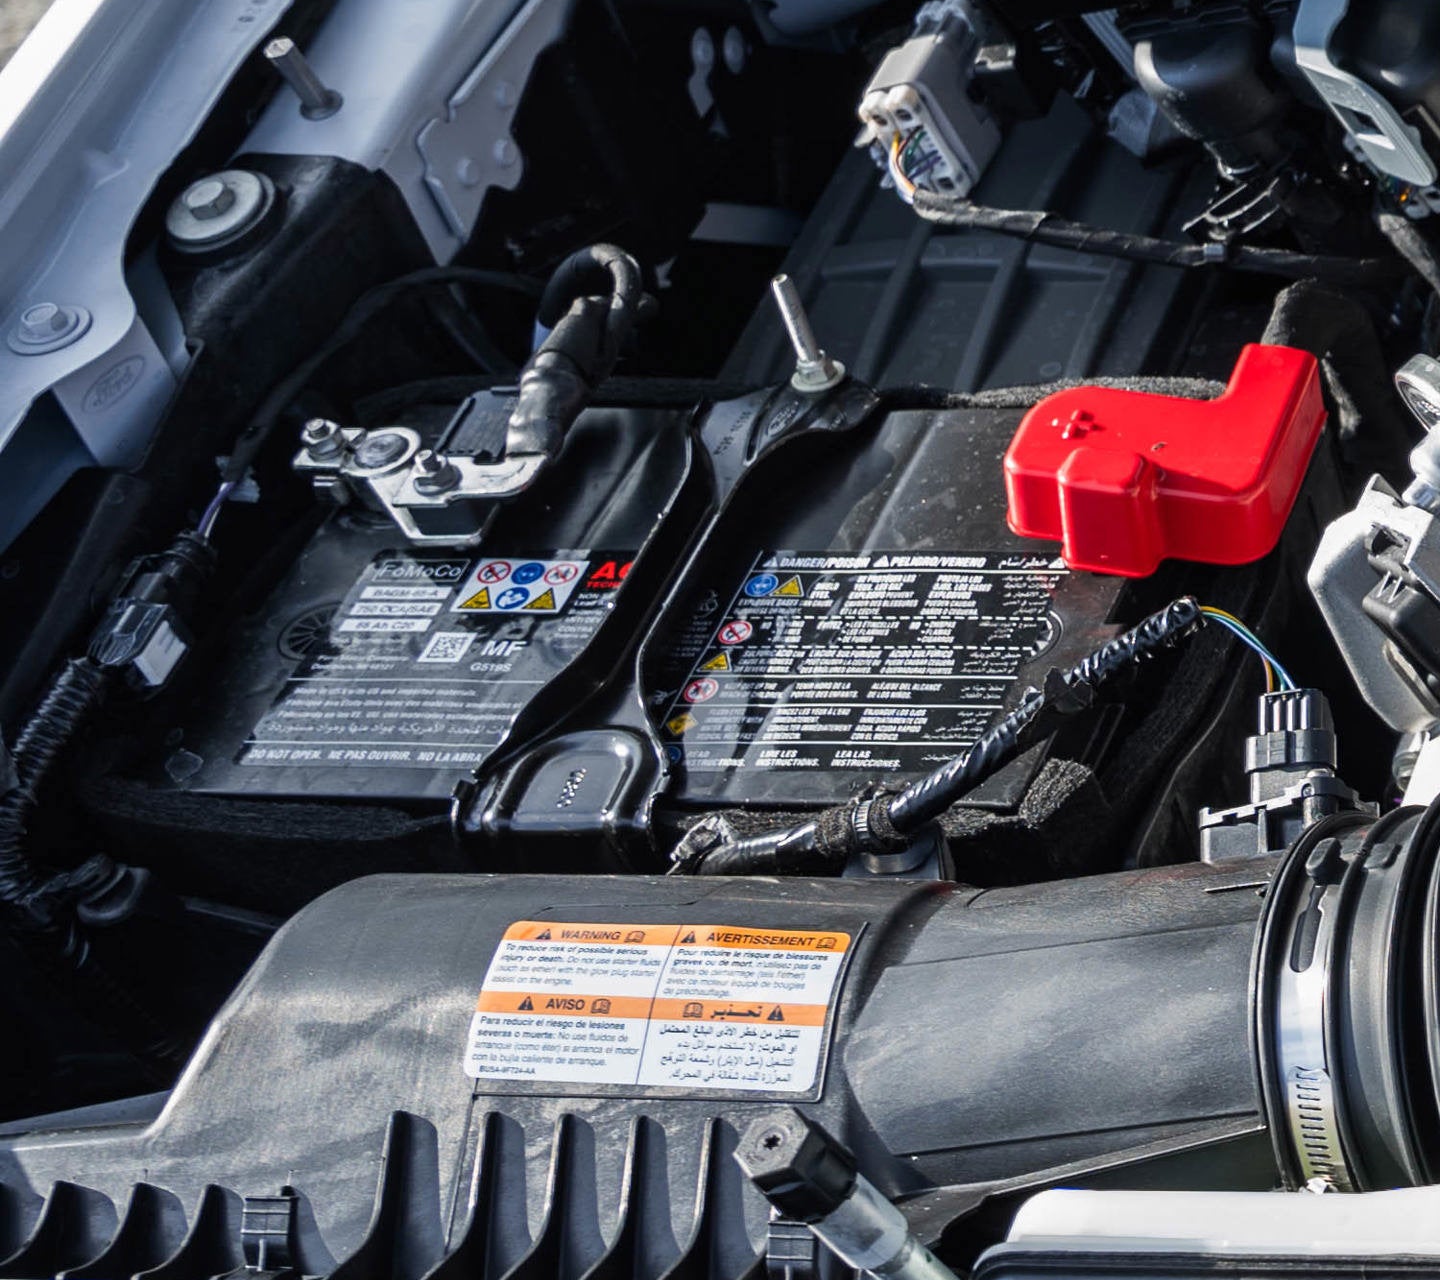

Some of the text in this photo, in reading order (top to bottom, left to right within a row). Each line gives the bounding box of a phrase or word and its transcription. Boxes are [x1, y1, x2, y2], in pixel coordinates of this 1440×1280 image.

[780, 557, 987, 568] DANGER/POISON PELIGRO/VENENO
[379, 564, 462, 577] FoMoCo
[481, 641, 526, 657] MF
[266, 750, 289, 759] NOT
[291, 751, 322, 760] OPEN.
[560, 930, 621, 940] WARNING
[707, 933, 816, 946] AVERTISSEMENT
[579, 946, 613, 955] possible
[546, 999, 584, 1010] AVISO
[589, 1021, 625, 1030] lesiones
